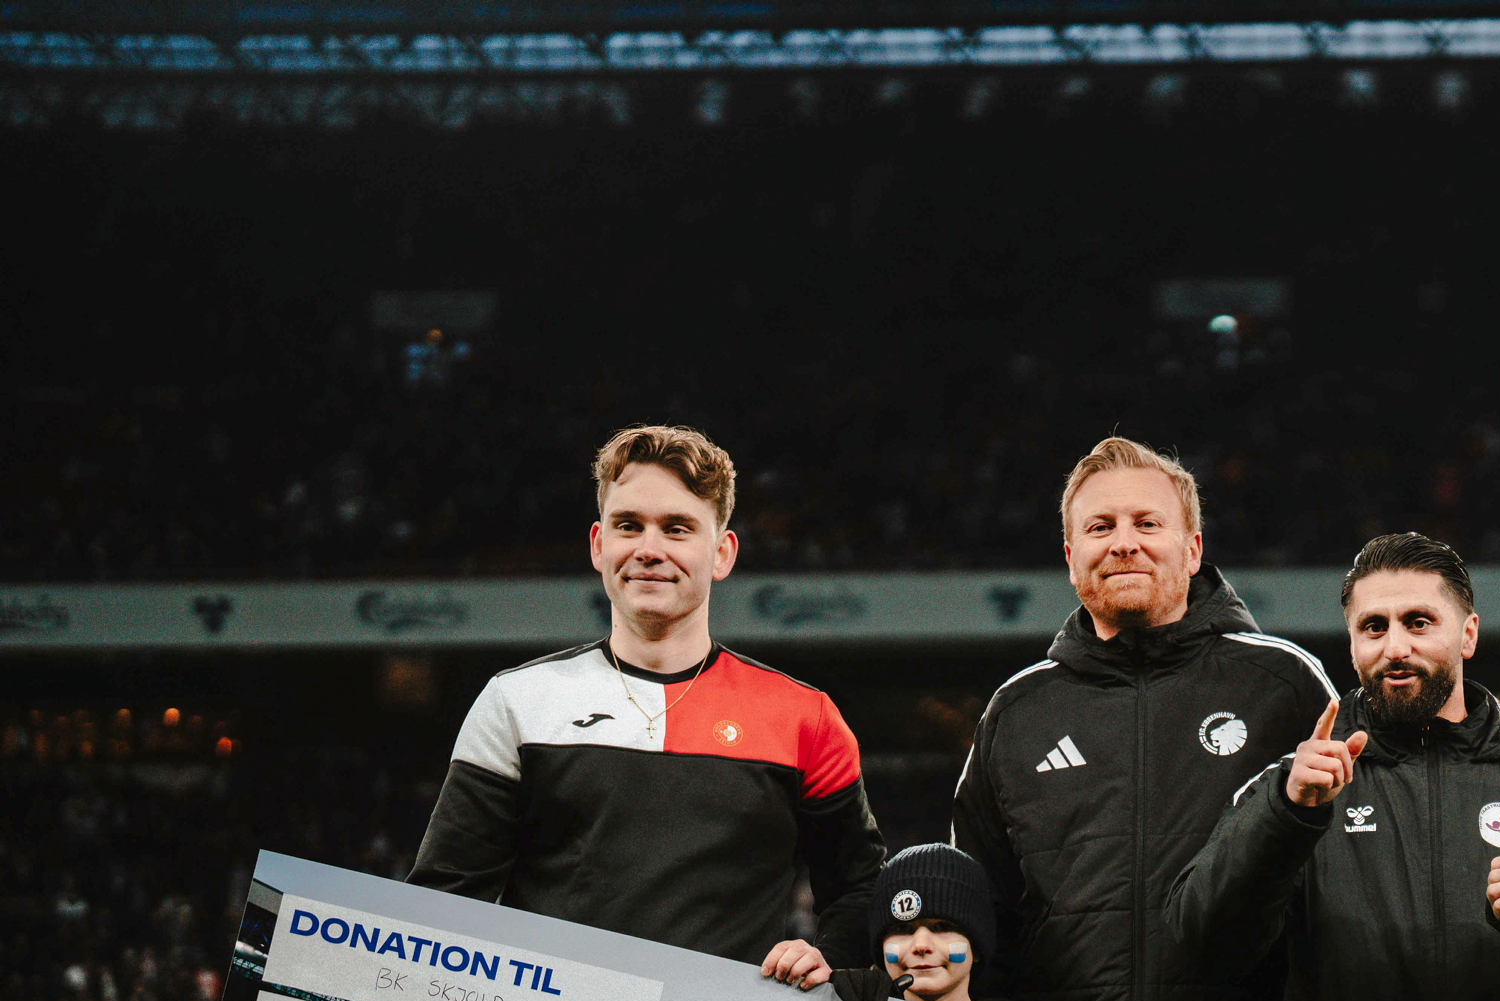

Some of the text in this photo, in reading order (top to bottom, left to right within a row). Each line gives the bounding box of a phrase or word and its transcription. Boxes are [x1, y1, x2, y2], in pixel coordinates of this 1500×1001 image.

[1344, 822, 1377, 833] hummel
[897, 896, 914, 913] 12
[289, 909, 562, 996] DONATION TIL
[375, 967, 408, 992] BK
